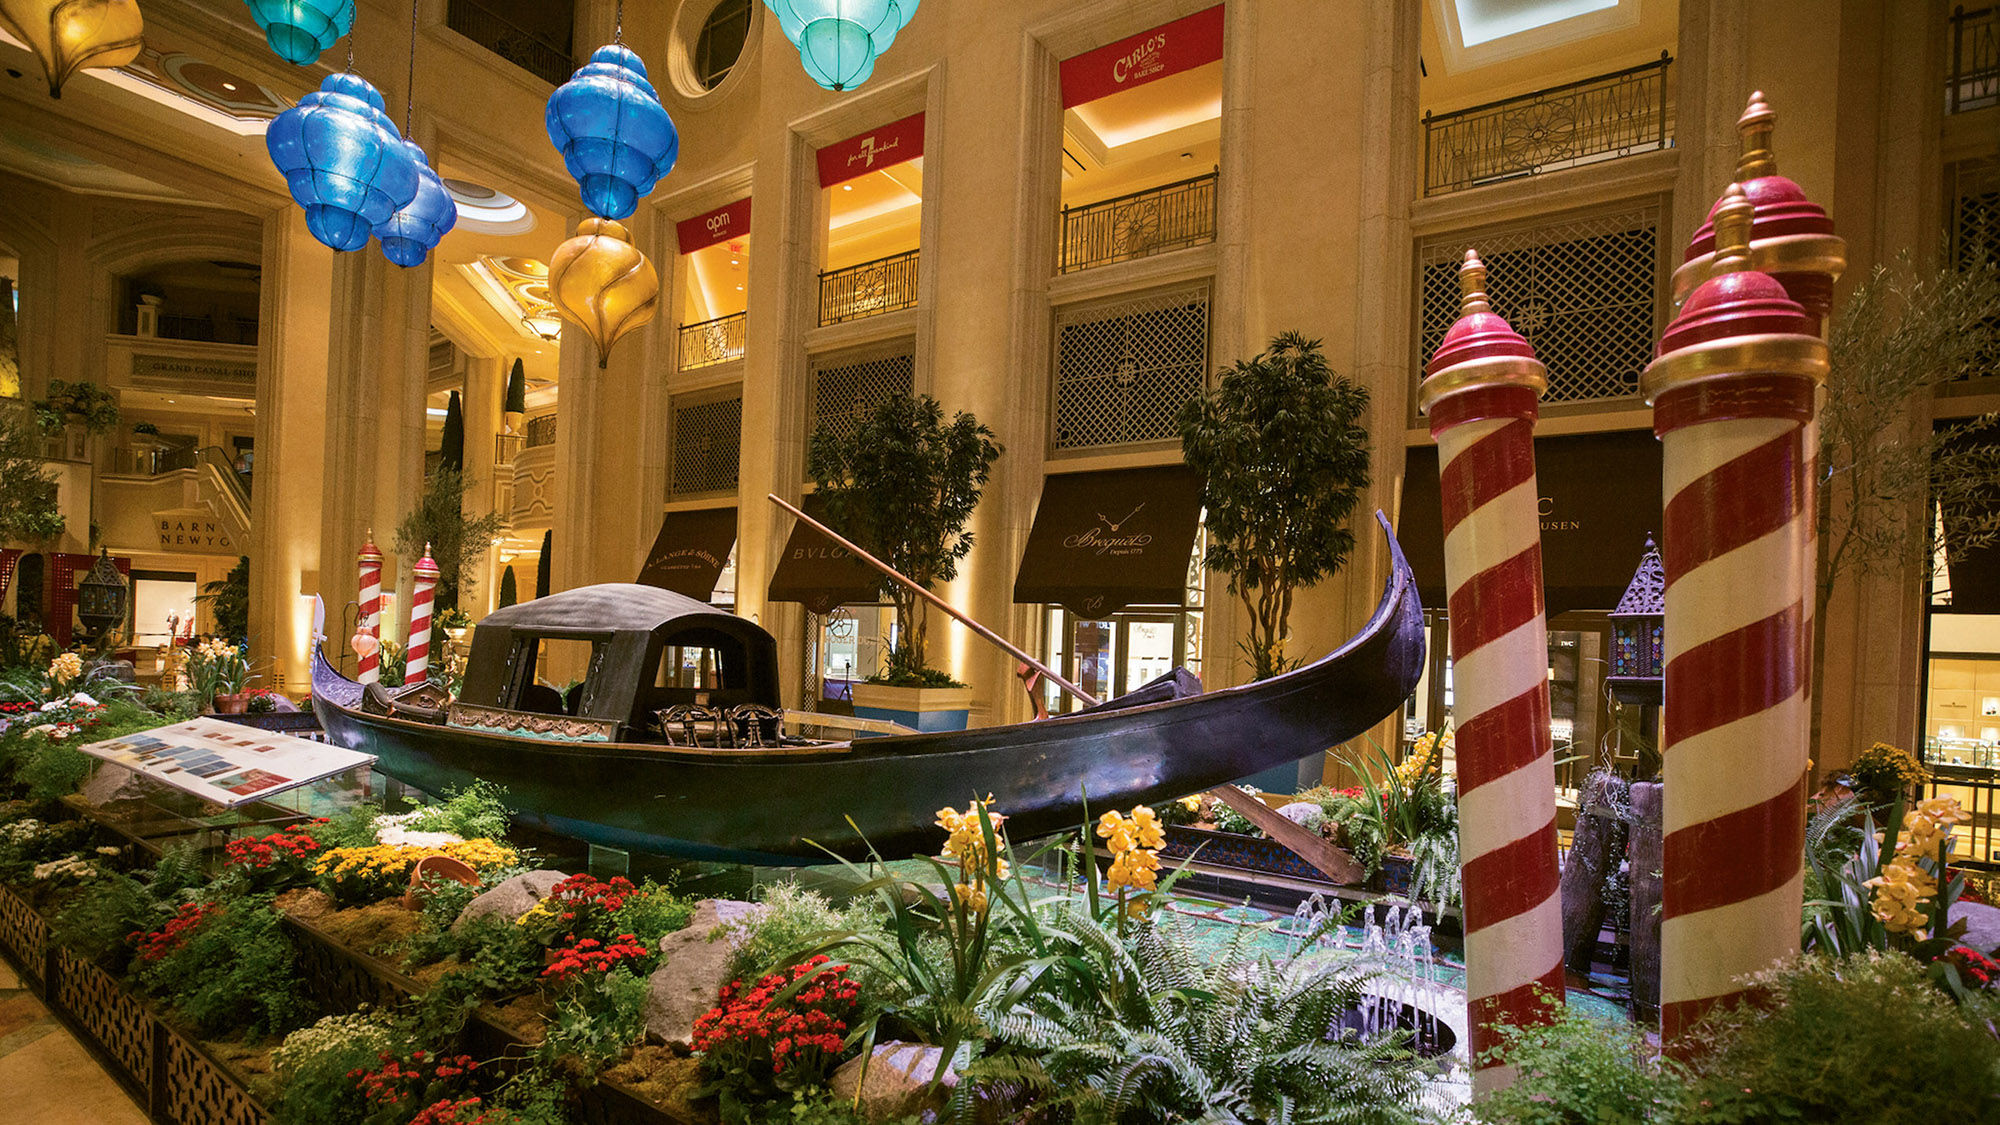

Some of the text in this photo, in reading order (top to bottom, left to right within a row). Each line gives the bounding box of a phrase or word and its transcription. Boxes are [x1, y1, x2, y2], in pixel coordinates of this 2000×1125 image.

[1113, 33, 1166, 83] CARLO'S
[706, 212, 730, 232] apm
[152, 363, 191, 373] GRAND
[194, 366, 231, 376] CANAL
[1063, 527, 1153, 555] Breguet
